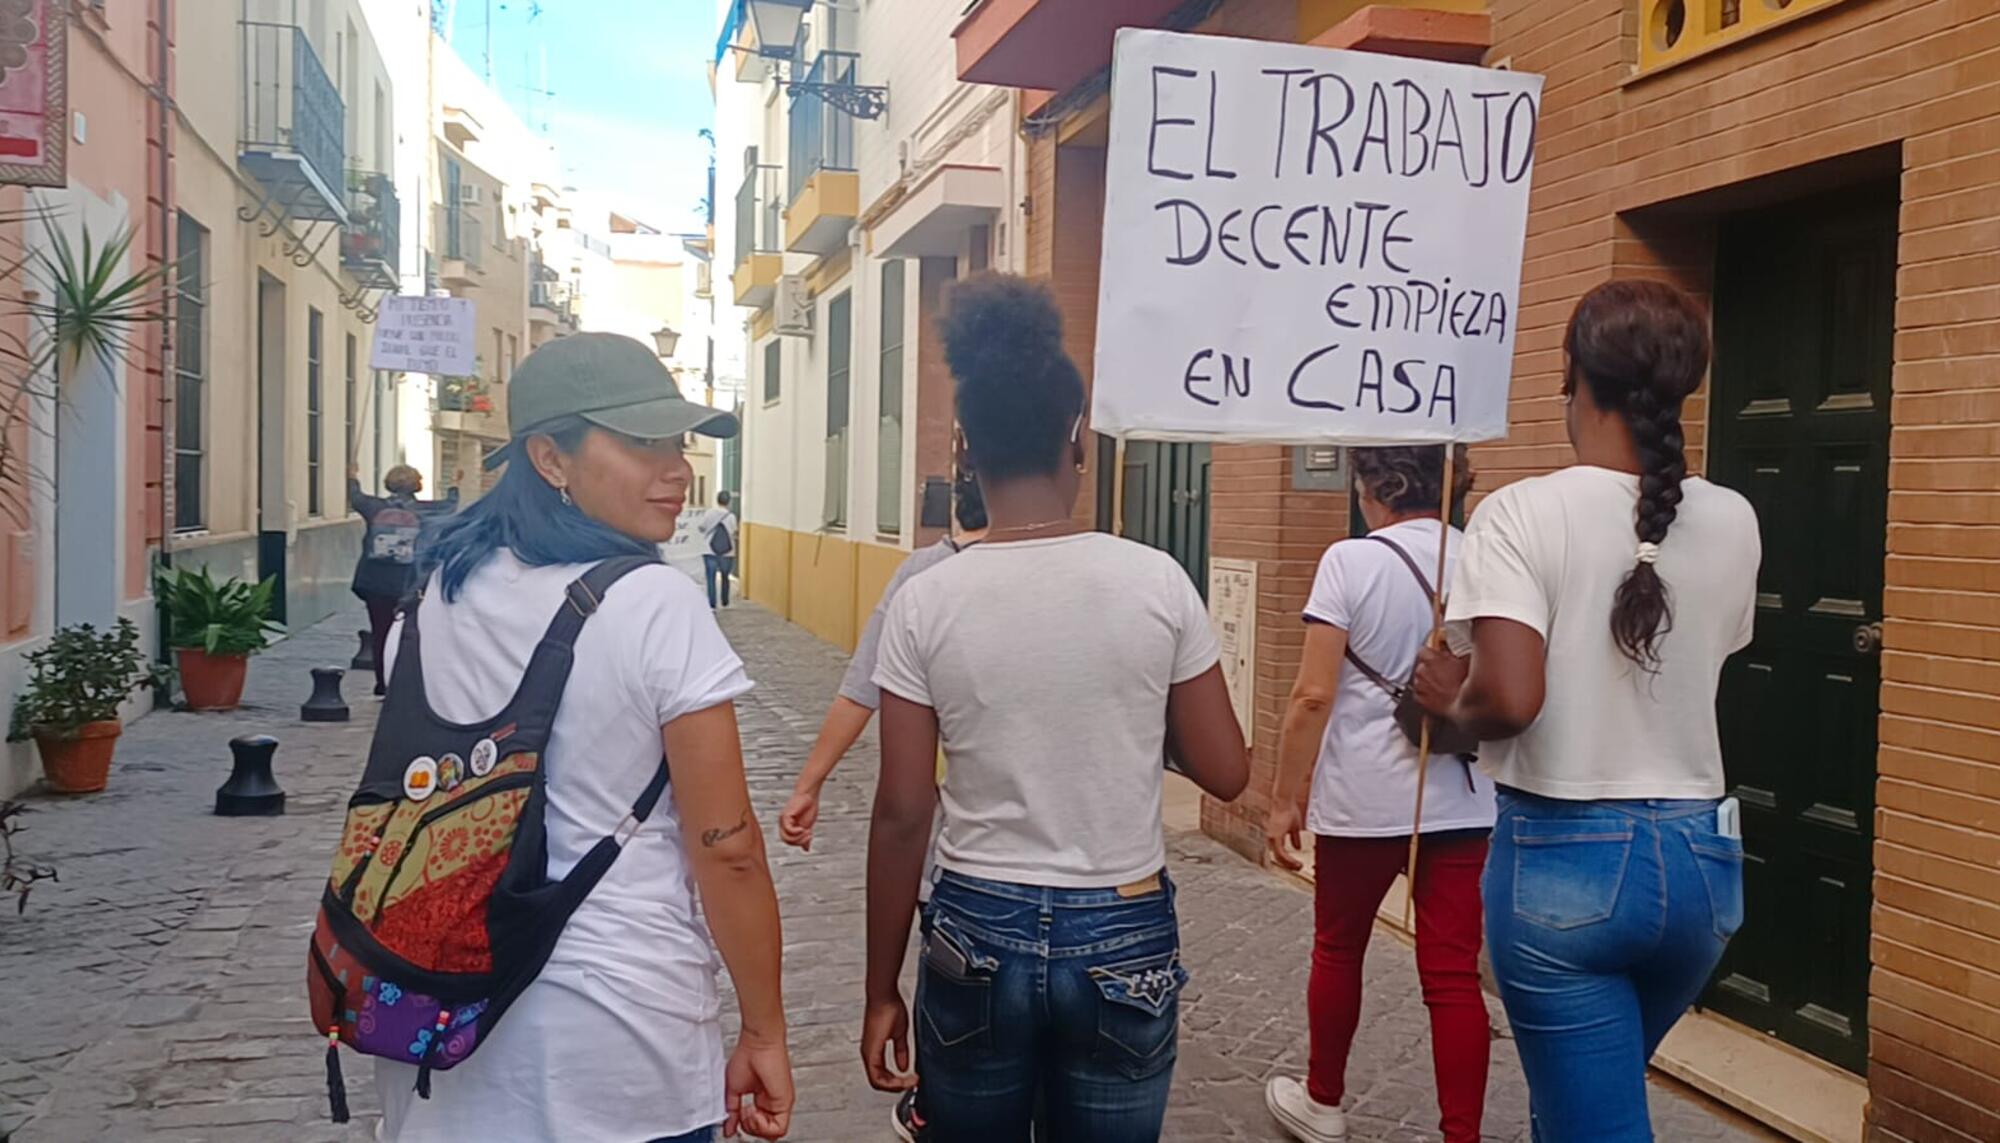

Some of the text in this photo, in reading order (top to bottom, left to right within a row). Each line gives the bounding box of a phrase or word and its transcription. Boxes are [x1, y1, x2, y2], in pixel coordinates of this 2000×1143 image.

[1147, 66, 1537, 187] EL TRABAJO
[1154, 199, 1413, 273] DECENTE
[1184, 344, 1456, 425] EN CASA
